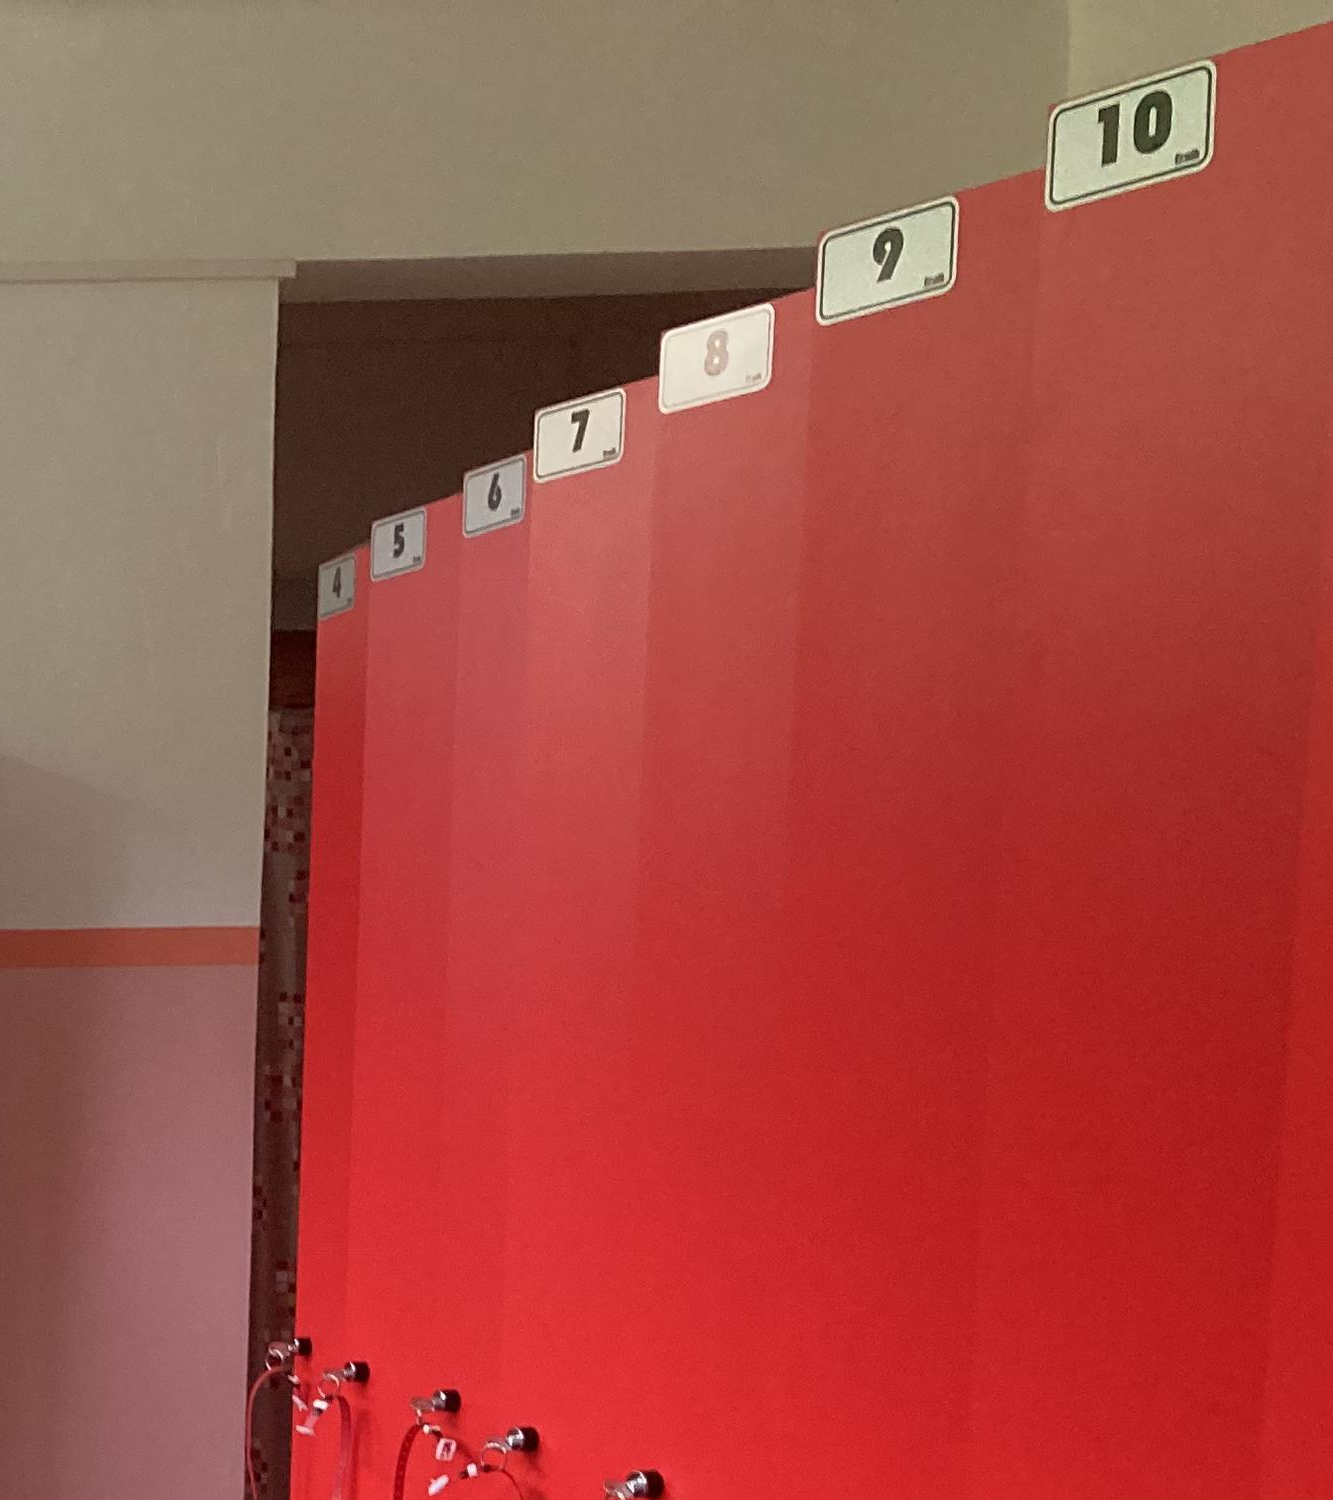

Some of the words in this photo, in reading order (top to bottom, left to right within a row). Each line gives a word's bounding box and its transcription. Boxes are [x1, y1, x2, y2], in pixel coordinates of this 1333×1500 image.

[1097, 89, 1173, 168] 10
[872, 226, 905, 283] 9
[703, 329, 729, 378] 8
[570, 408, 590, 453] 7
[487, 472, 503, 512] 6
[393, 522, 405, 559] 5
[332, 566, 342, 599] 4
